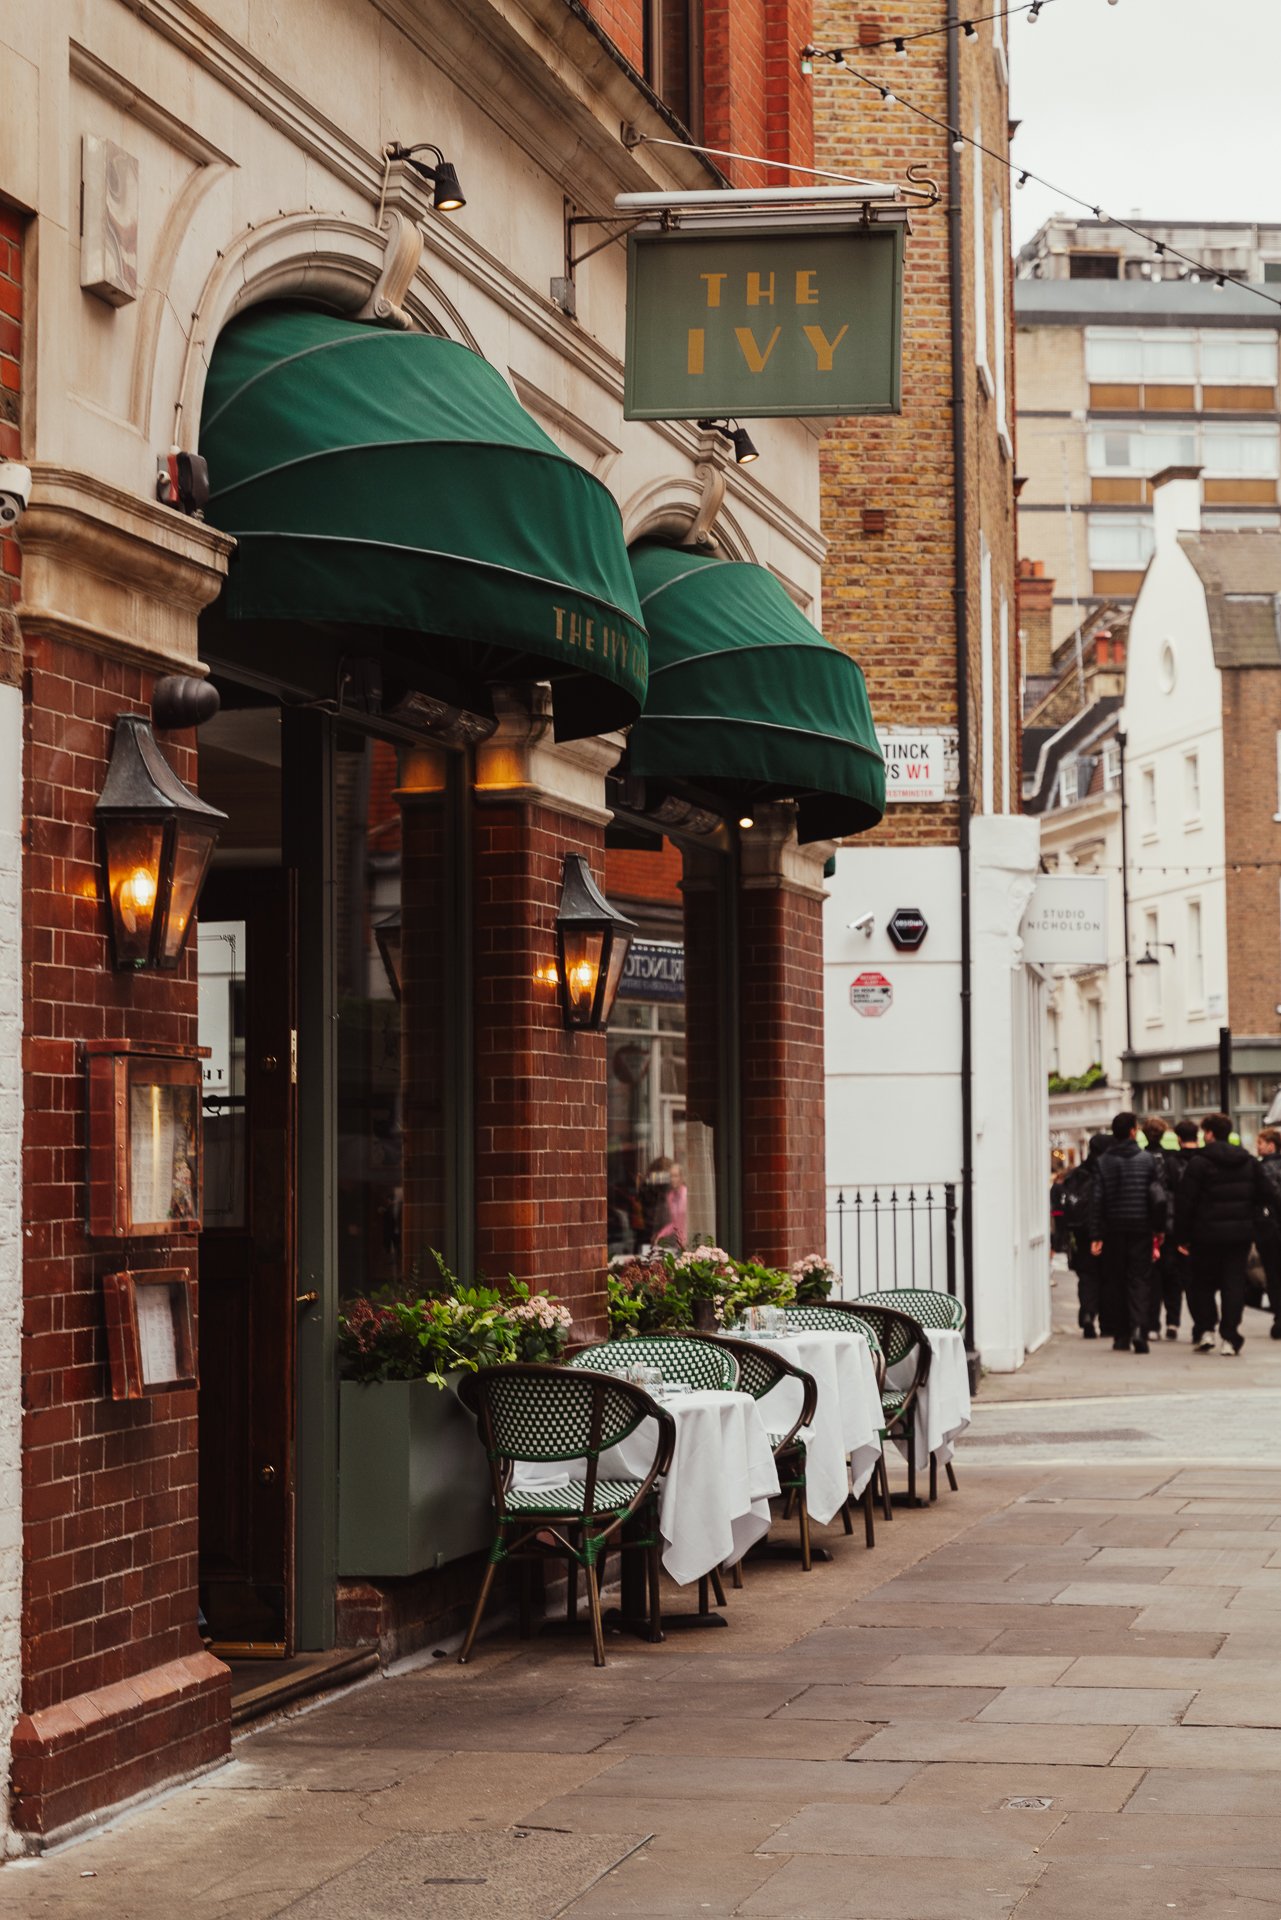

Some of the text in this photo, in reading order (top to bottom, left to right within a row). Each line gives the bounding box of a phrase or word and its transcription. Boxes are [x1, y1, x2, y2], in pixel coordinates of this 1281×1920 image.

[700, 270, 819, 307] THE
[687, 324, 849, 374] IVY
[553, 606, 595, 652] THE
[603, 626, 629, 668] IVY
[906, 764, 929, 779] W1
[1027, 921, 1100, 931] NICHOLSON
[1043, 909, 1085, 919] STUDIO
